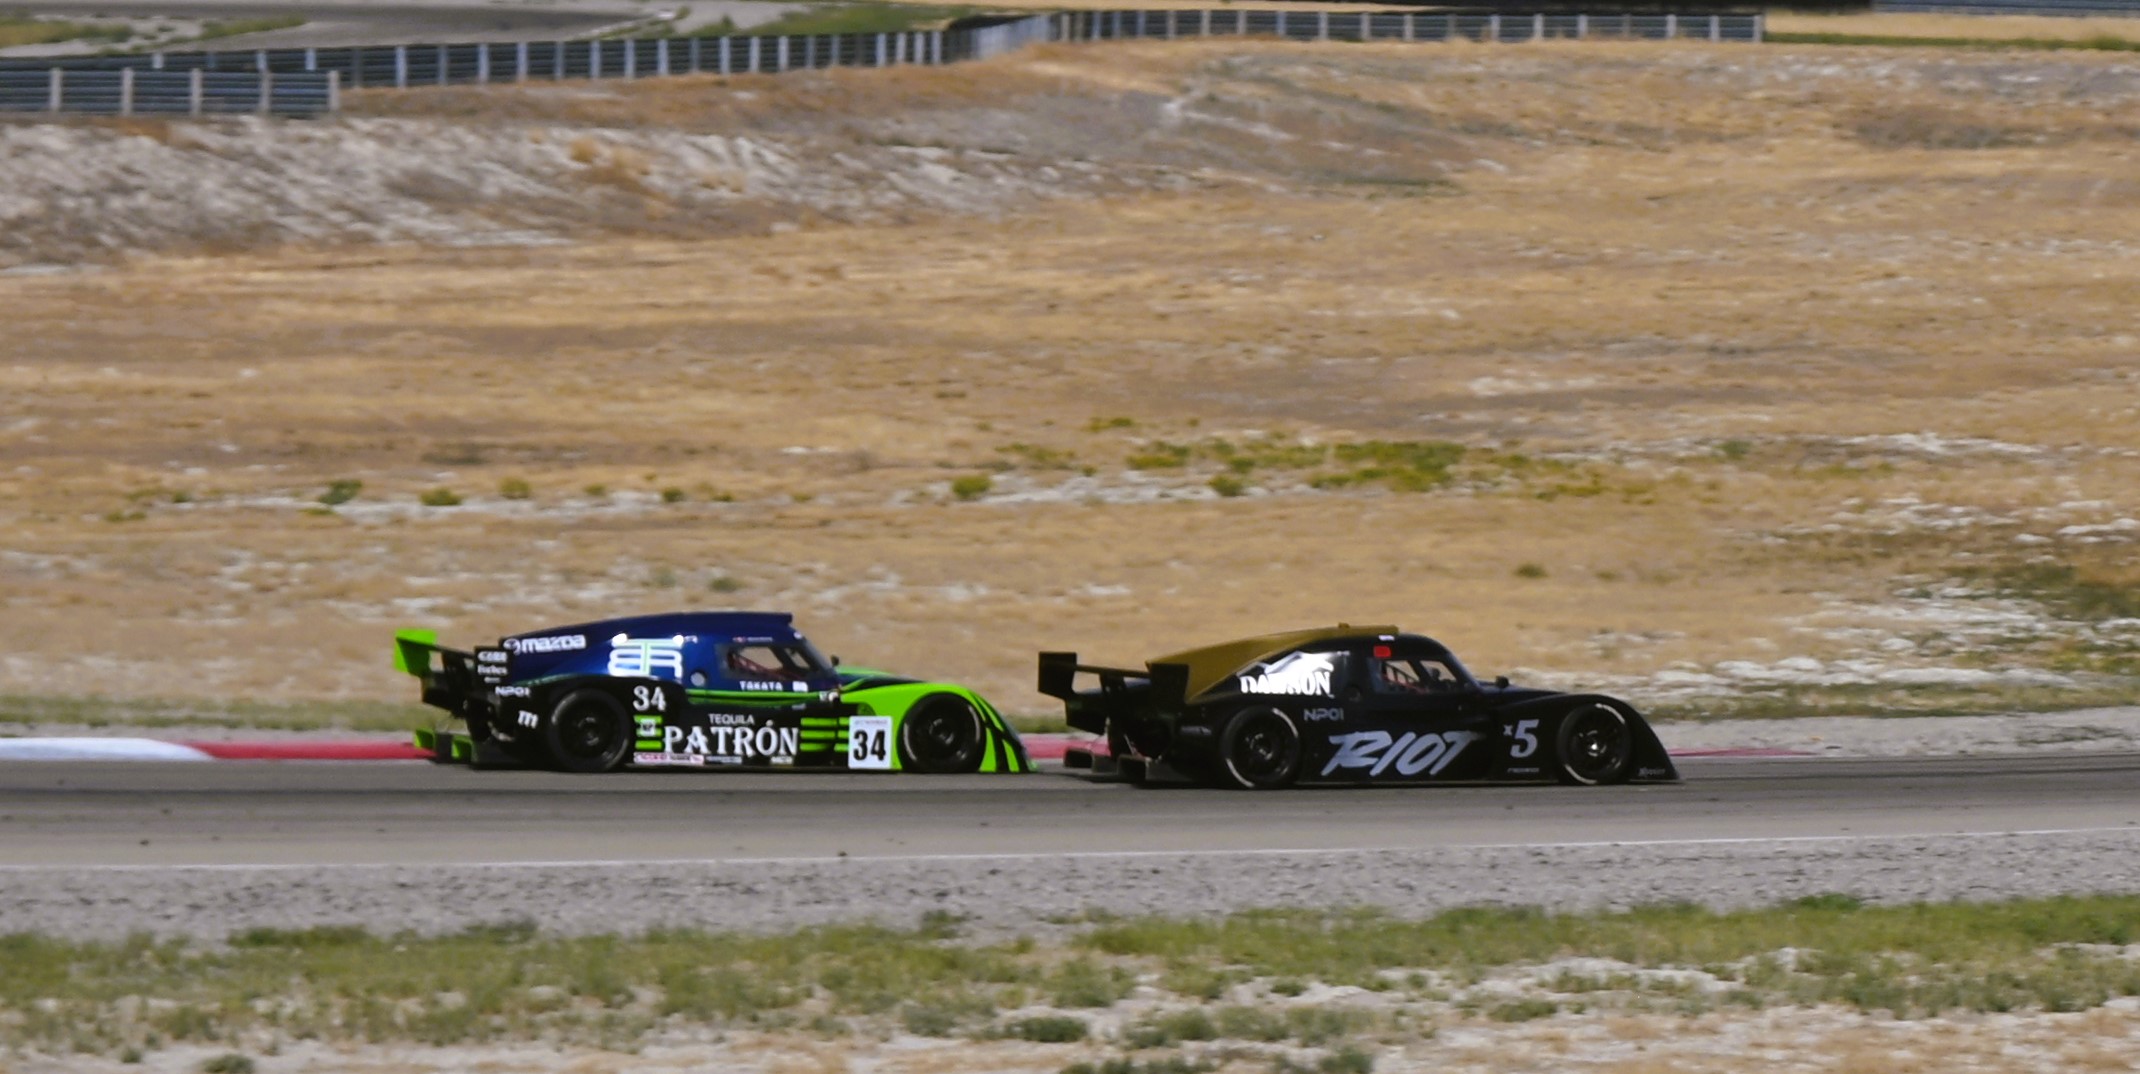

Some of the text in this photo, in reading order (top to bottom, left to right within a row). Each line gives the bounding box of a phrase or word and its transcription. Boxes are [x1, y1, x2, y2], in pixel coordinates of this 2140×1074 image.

[633, 685, 667, 712] 34
[739, 681, 783, 692] TAKATA
[709, 713, 755, 725] TEQUILA
[663, 719, 799, 757] PATRÓN
[853, 729, 886, 762] 34
[1320, 730, 1486, 776] RIOT
